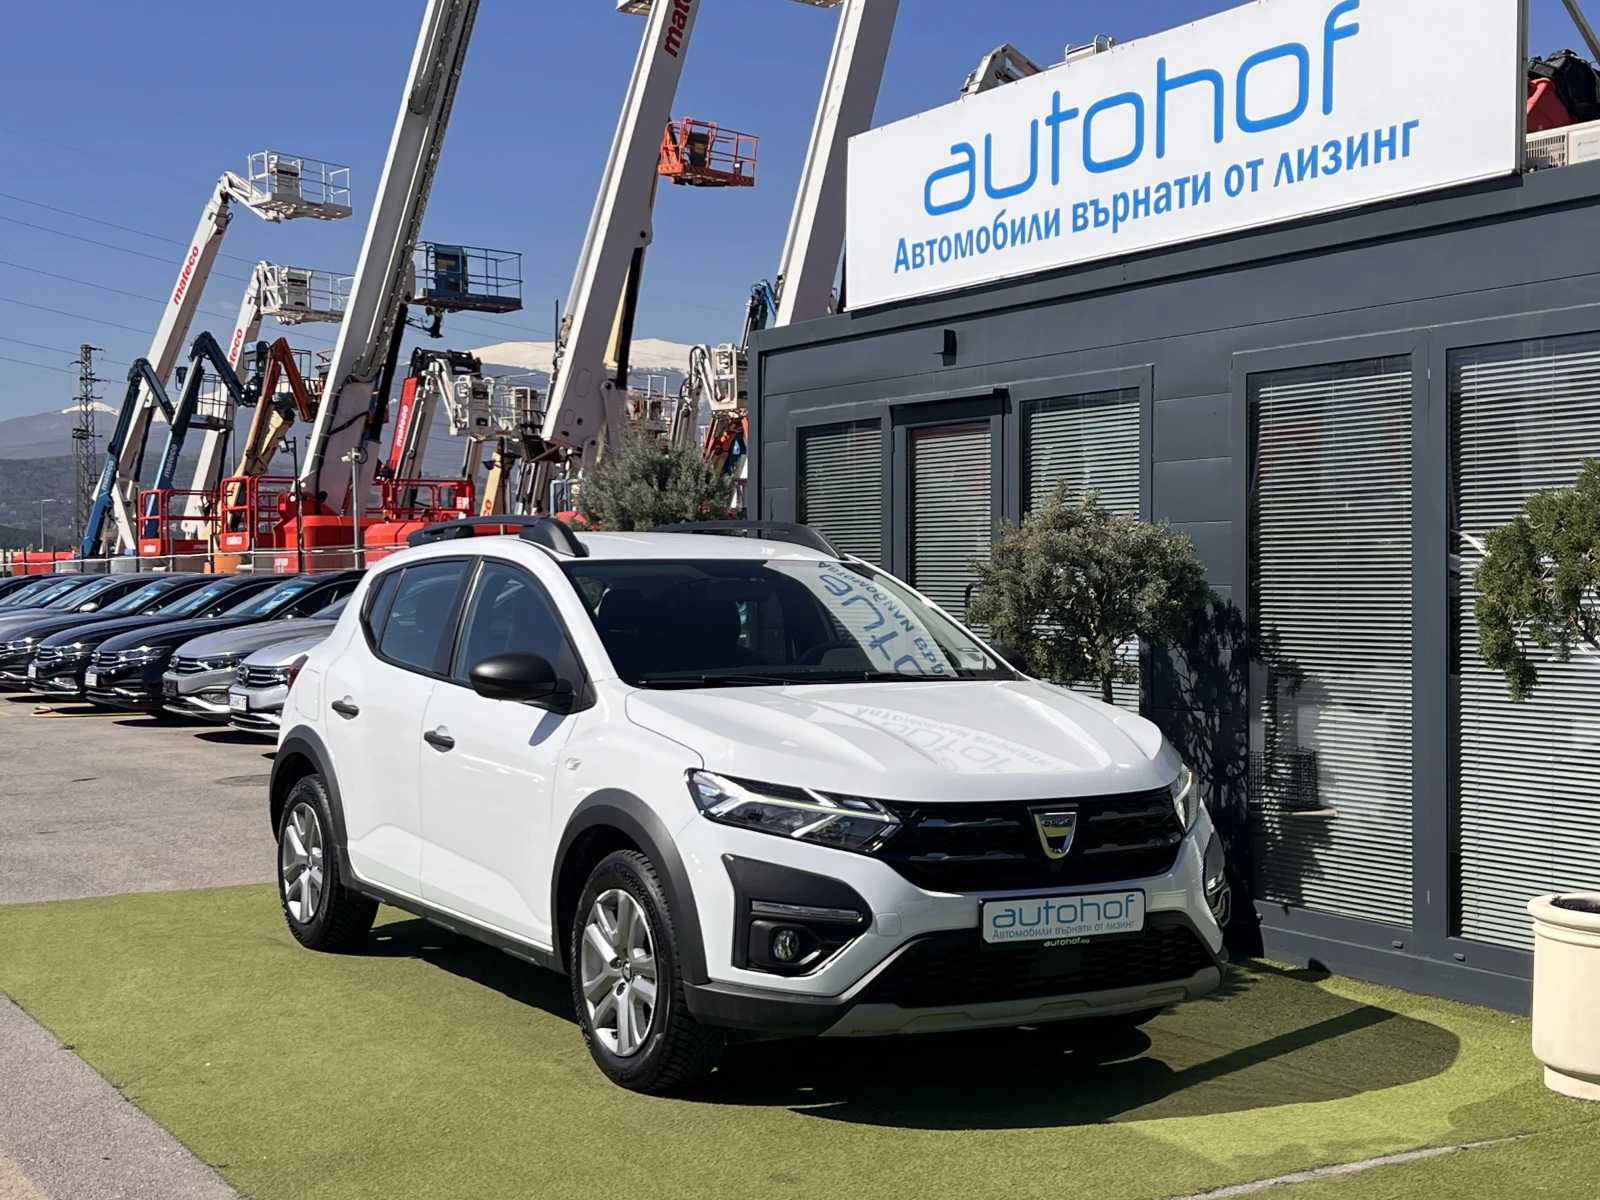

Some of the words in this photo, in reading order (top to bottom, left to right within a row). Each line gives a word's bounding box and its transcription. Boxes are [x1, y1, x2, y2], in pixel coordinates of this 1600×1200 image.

[664, 0, 693, 58] mat
[924, 0, 1360, 216] autohof
[894, 209, 1061, 274] Автомобили
[1072, 171, 1212, 234] върнати
[1224, 158, 1265, 197] от
[1274, 119, 1420, 188] лизинг
[173, 245, 199, 306] mateco
[396, 405, 408, 448] mateco
[101, 460, 115, 491] mateco
[992, 894, 1136, 928] autohof
[992, 926, 1052, 940] Автомобили
[1055, 924, 1093, 935] върнати
[1094, 922, 1104, 931] от
[1105, 920, 1136, 931] лизинг
